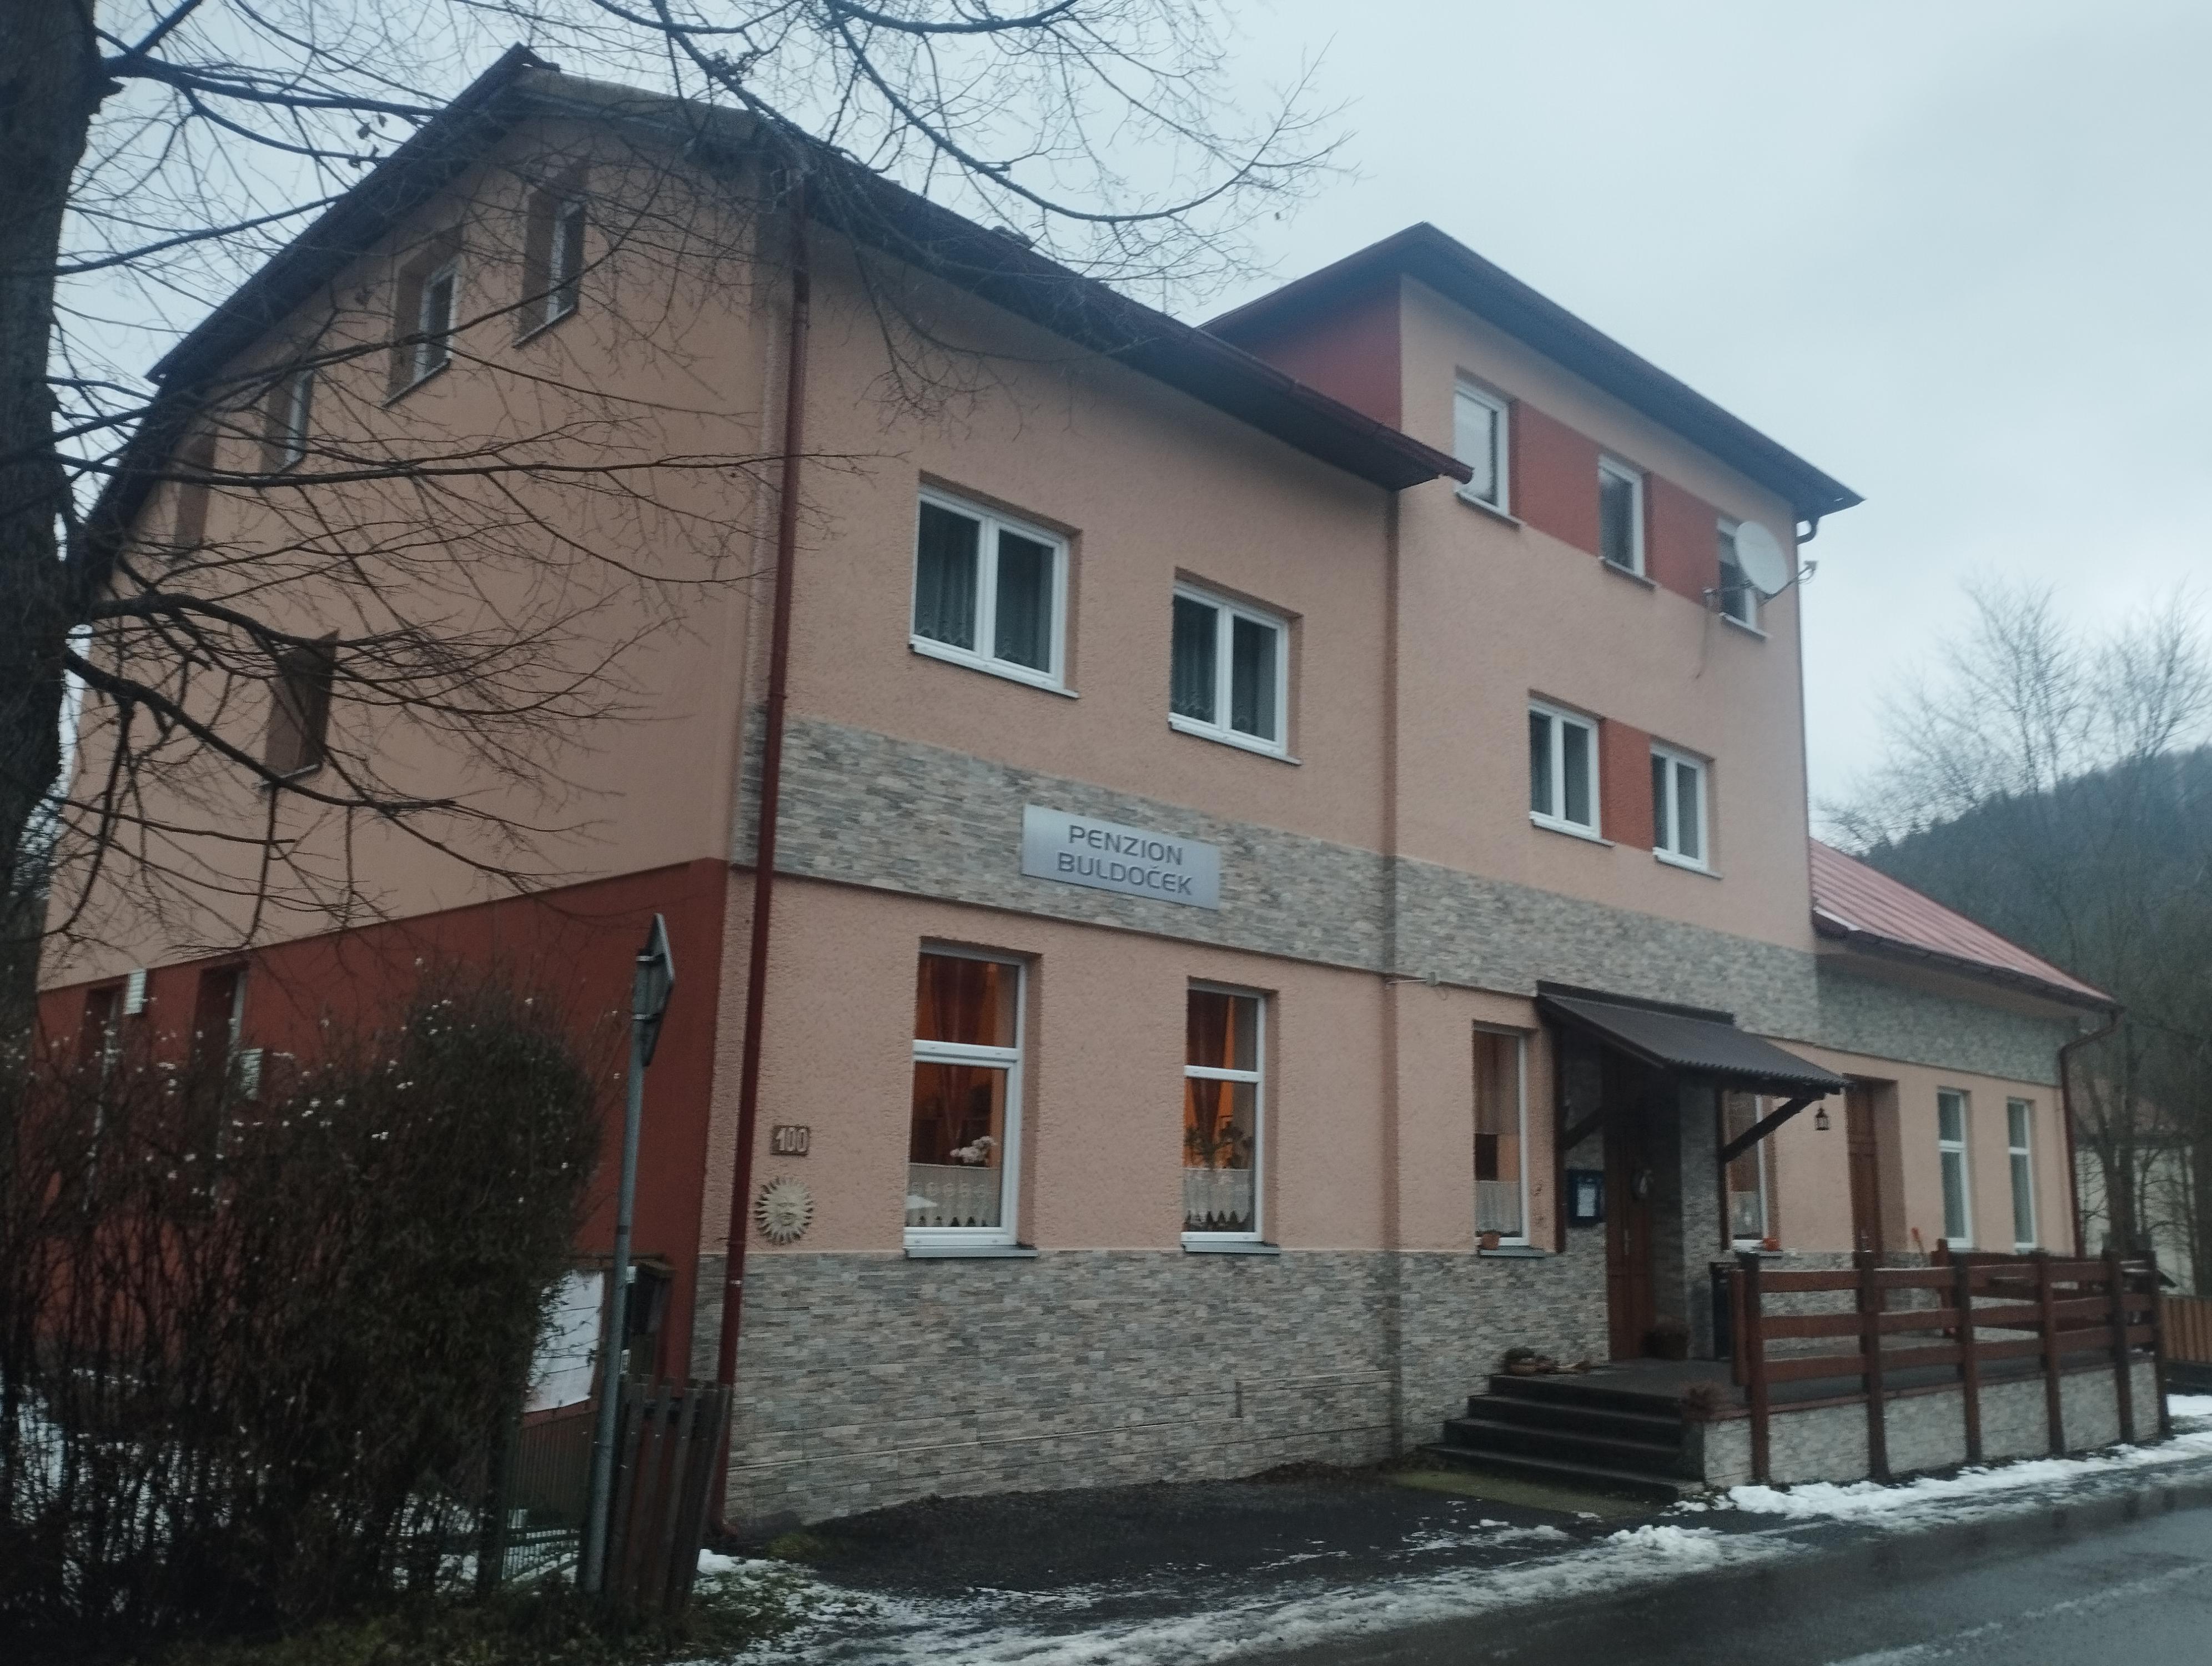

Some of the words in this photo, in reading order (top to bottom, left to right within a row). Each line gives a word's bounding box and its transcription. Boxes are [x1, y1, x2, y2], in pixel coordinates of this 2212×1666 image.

[1068, 825, 1183, 865] PENZION
[1058, 852, 1193, 895] BULDOČEK
[776, 1127, 807, 1152] 100
